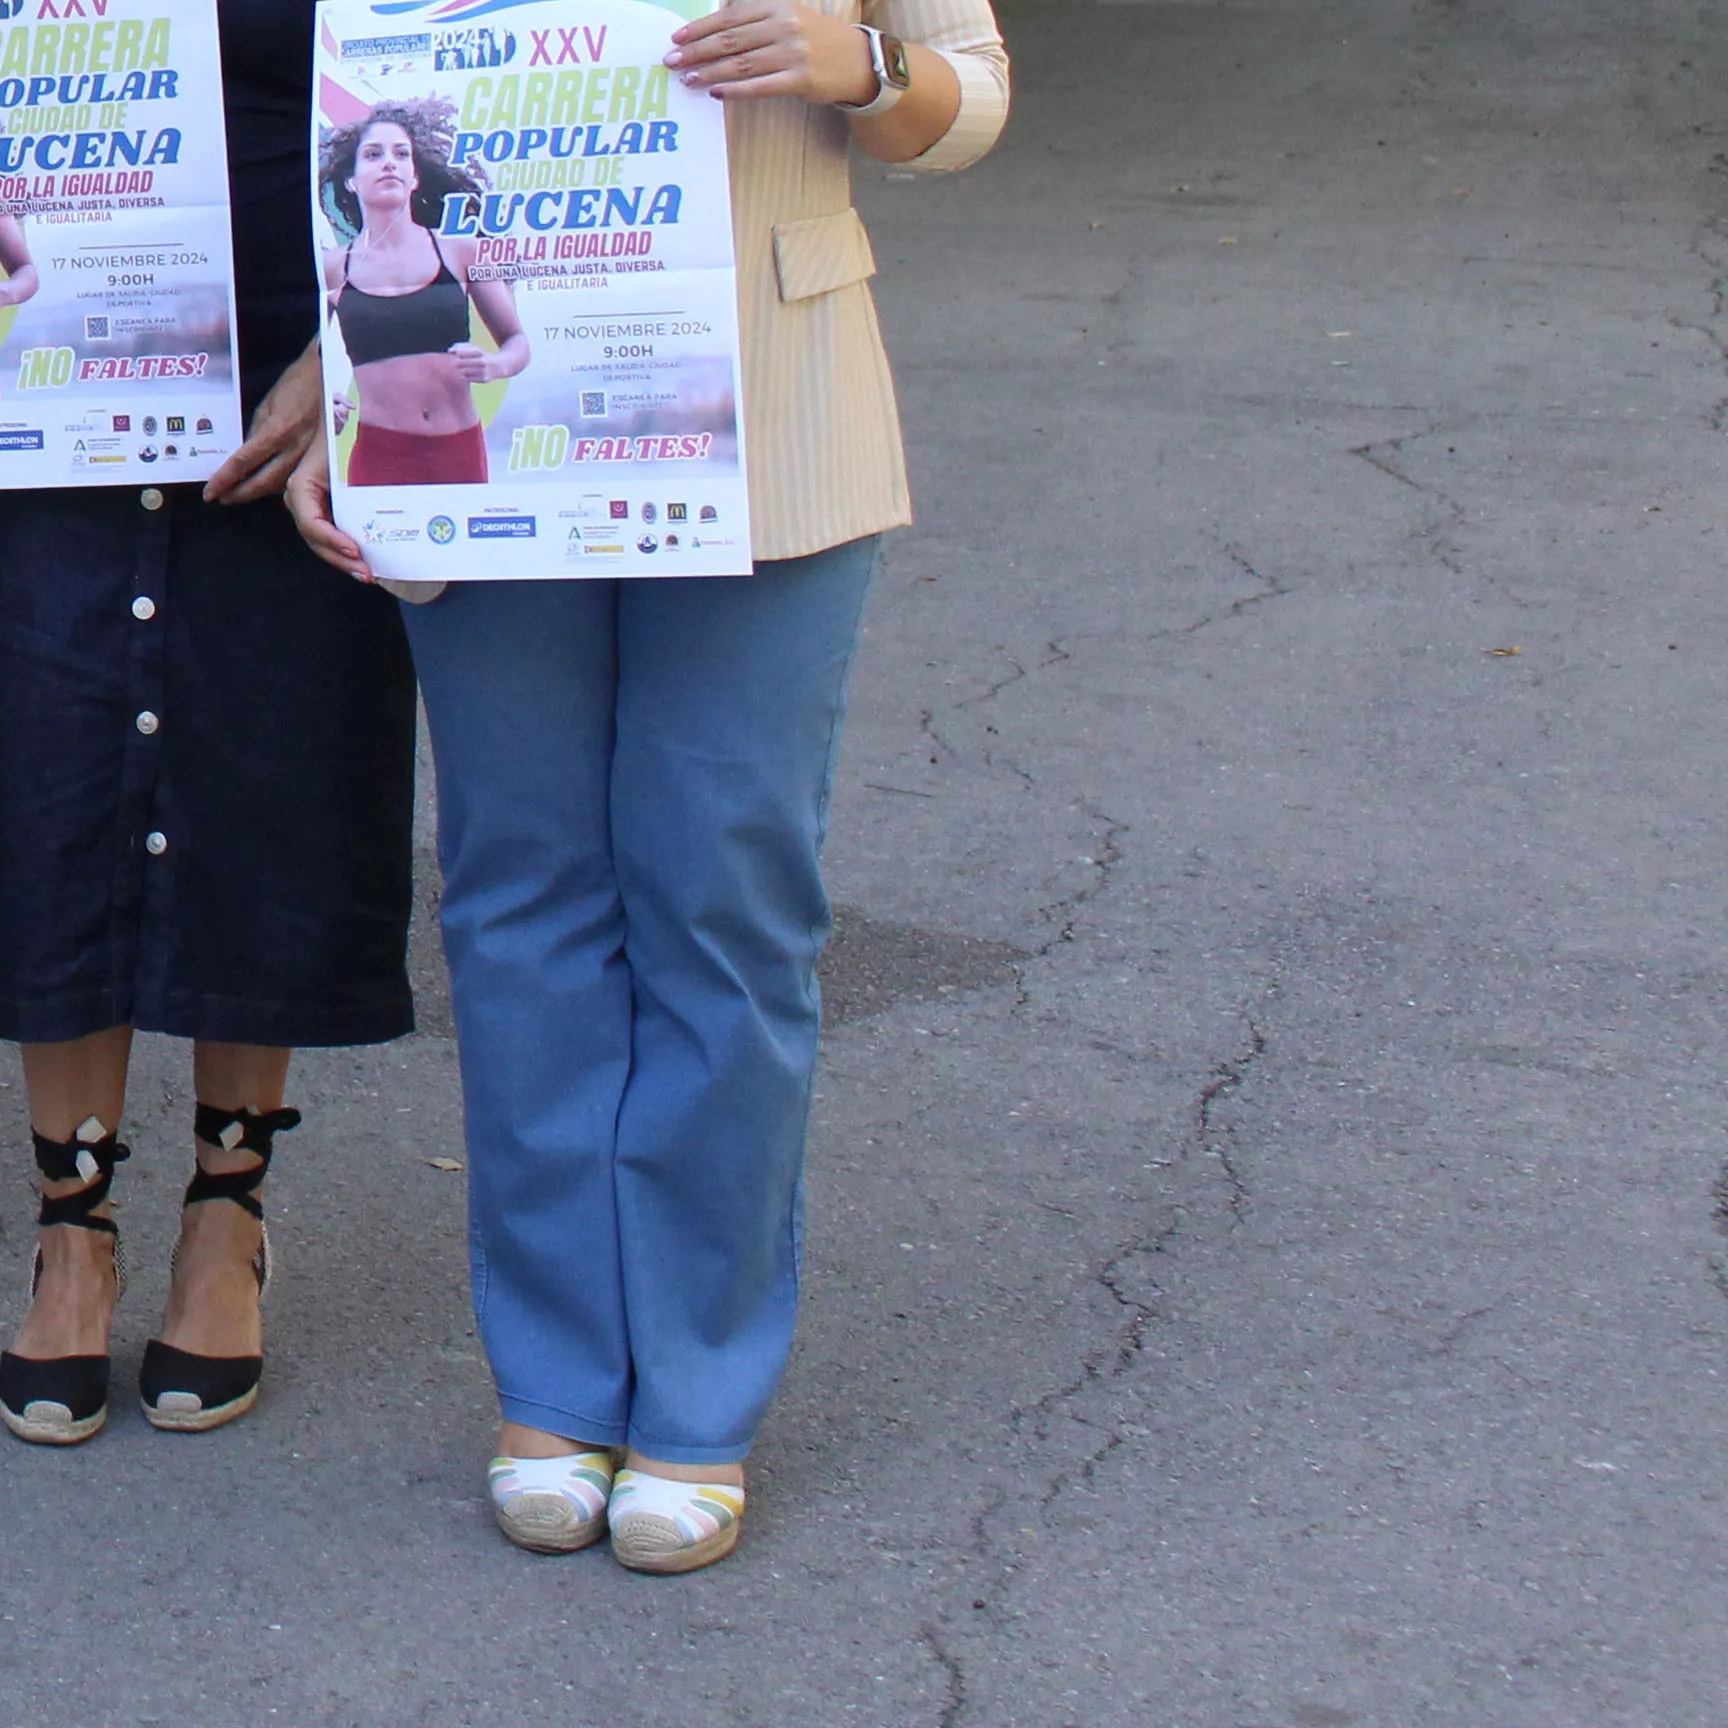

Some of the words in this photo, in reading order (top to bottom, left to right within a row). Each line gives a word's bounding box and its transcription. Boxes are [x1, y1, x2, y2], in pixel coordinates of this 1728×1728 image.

[432, 28, 479, 50] 2024
[529, 25, 607, 67] XXV
[461, 65, 670, 130] CARRERA
[7, 105, 92, 135] CIUDAD
[100, 102, 128, 129] DE
[450, 120, 679, 165] POPULAR
[33, 175, 55, 198] LA
[61, 170, 154, 197] IGUALDAD
[496, 158, 584, 190] CIUDAD
[593, 157, 625, 186] DE
[6, 203, 27, 214] UNA
[31, 200, 74, 211] LUCENA
[119, 197, 165, 208] DIVERSA
[440, 184, 683, 237] LUCENA
[36, 215, 43, 225] E
[47, 212, 113, 224] IGUALITARIA
[476, 238, 518, 263] POR
[522, 236, 547, 262] LA
[553, 231, 652, 260] IGUALDAD
[52, 257, 66, 270] 17
[71, 254, 166, 269] NOVIEMBRE
[171, 252, 209, 265] 2024
[469, 267, 492, 280] POR
[495, 267, 519, 279] UNA
[522, 265, 567, 277] LUCENA
[616, 260, 665, 272] DIVERSA
[107, 273, 154, 286] 9:00H
[526, 280, 534, 291] E
[537, 277, 608, 290] IGUALITARIA
[544, 327, 559, 341] 17
[564, 323, 667, 339] NOVIEMBRE
[671, 322, 712, 336] 2024
[603, 344, 654, 359] 9:00H
[19, 348, 74, 390] ¡NO
[79, 354, 208, 380] FALTES!
[510, 425, 568, 471] ¡NO
[574, 433, 713, 461] FALTES!
[483, 522, 532, 533] DECATHLON
